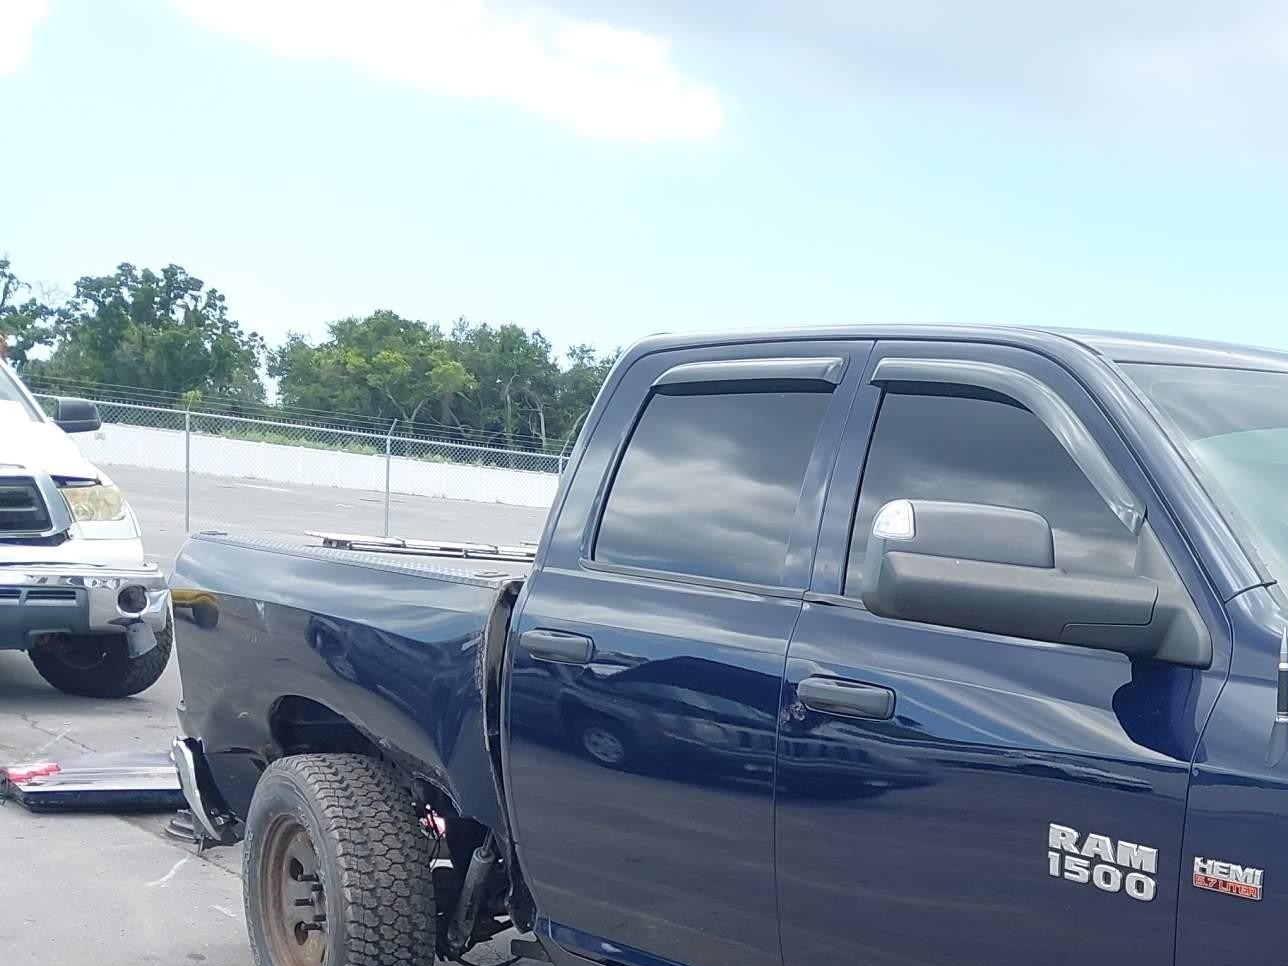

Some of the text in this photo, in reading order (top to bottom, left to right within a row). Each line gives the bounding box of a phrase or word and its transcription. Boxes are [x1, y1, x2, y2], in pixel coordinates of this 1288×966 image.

[1048, 823, 1159, 874] RAM
[1047, 851, 1157, 902] 1500
[1194, 856, 1265, 886] HEMI
[1194, 874, 1260, 898] 5.7 LITER
